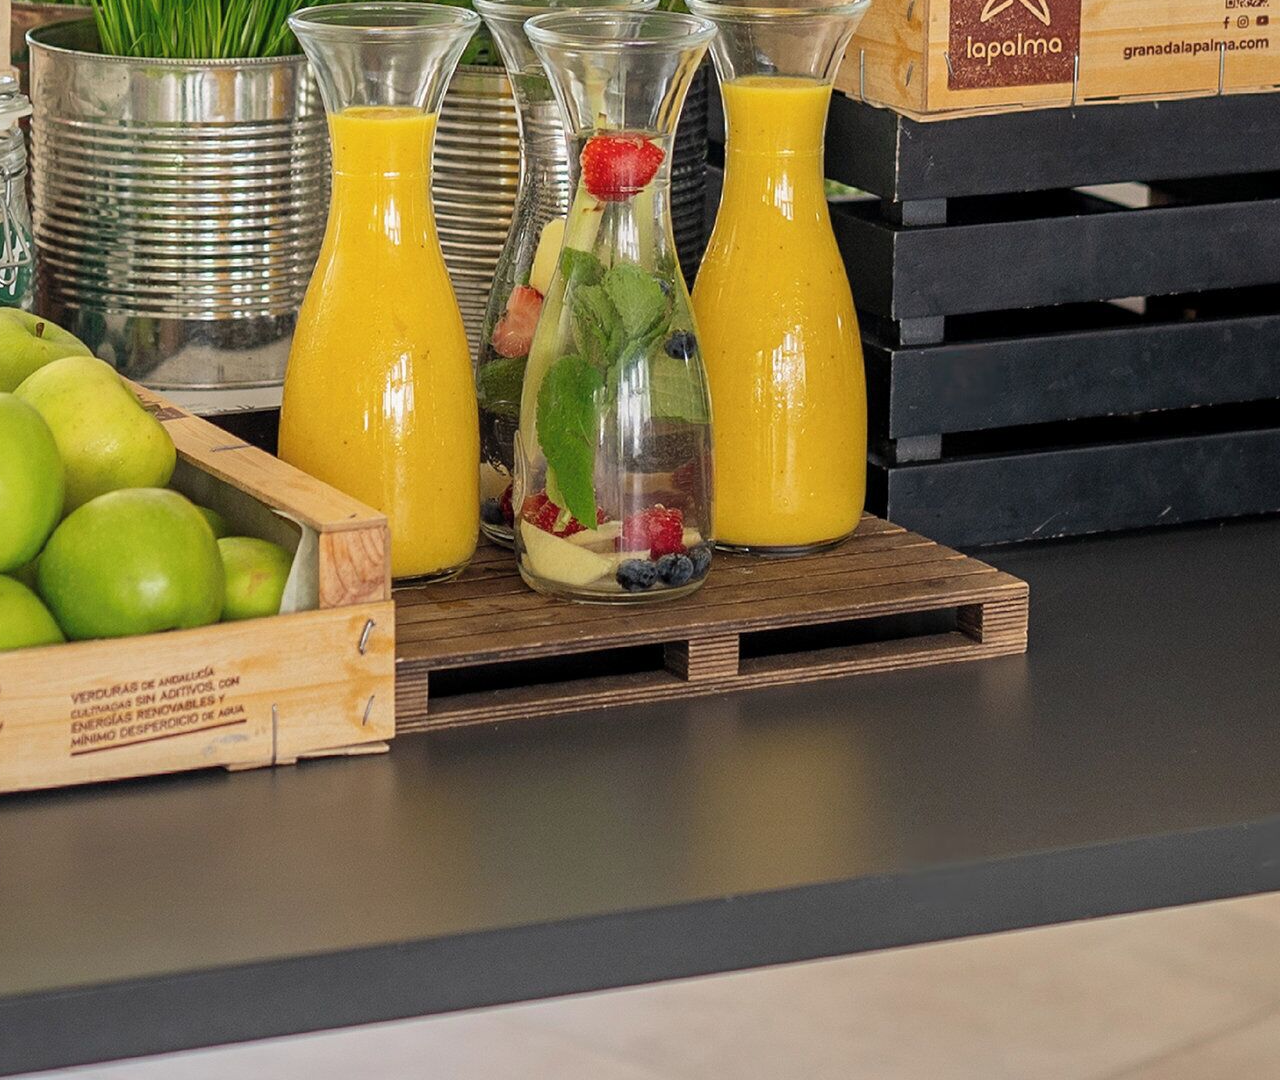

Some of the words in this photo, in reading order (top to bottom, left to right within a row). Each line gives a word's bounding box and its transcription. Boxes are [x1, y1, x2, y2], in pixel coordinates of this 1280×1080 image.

[967, 32, 1062, 66] lapalma
[1123, 36, 1269, 61] granadalapalma.com
[70, 680, 138, 704] VERDURAS
[141, 679, 156, 691] DE
[158, 665, 215, 687] ANDALUCÍA
[70, 700, 132, 719] CULTIVADAS
[135, 693, 156, 707] SIN
[218, 676, 241, 690] CON
[70, 709, 133, 734] ENERGÍAS
[136, 694, 216, 721] RENOVABLES
[218, 694, 226, 704] Y
[70, 730, 116, 748] MÍNIMO
[119, 713, 200, 738] DESPERDICIO
[201, 711, 215, 721] DE
[218, 703, 245, 719] AGUA
